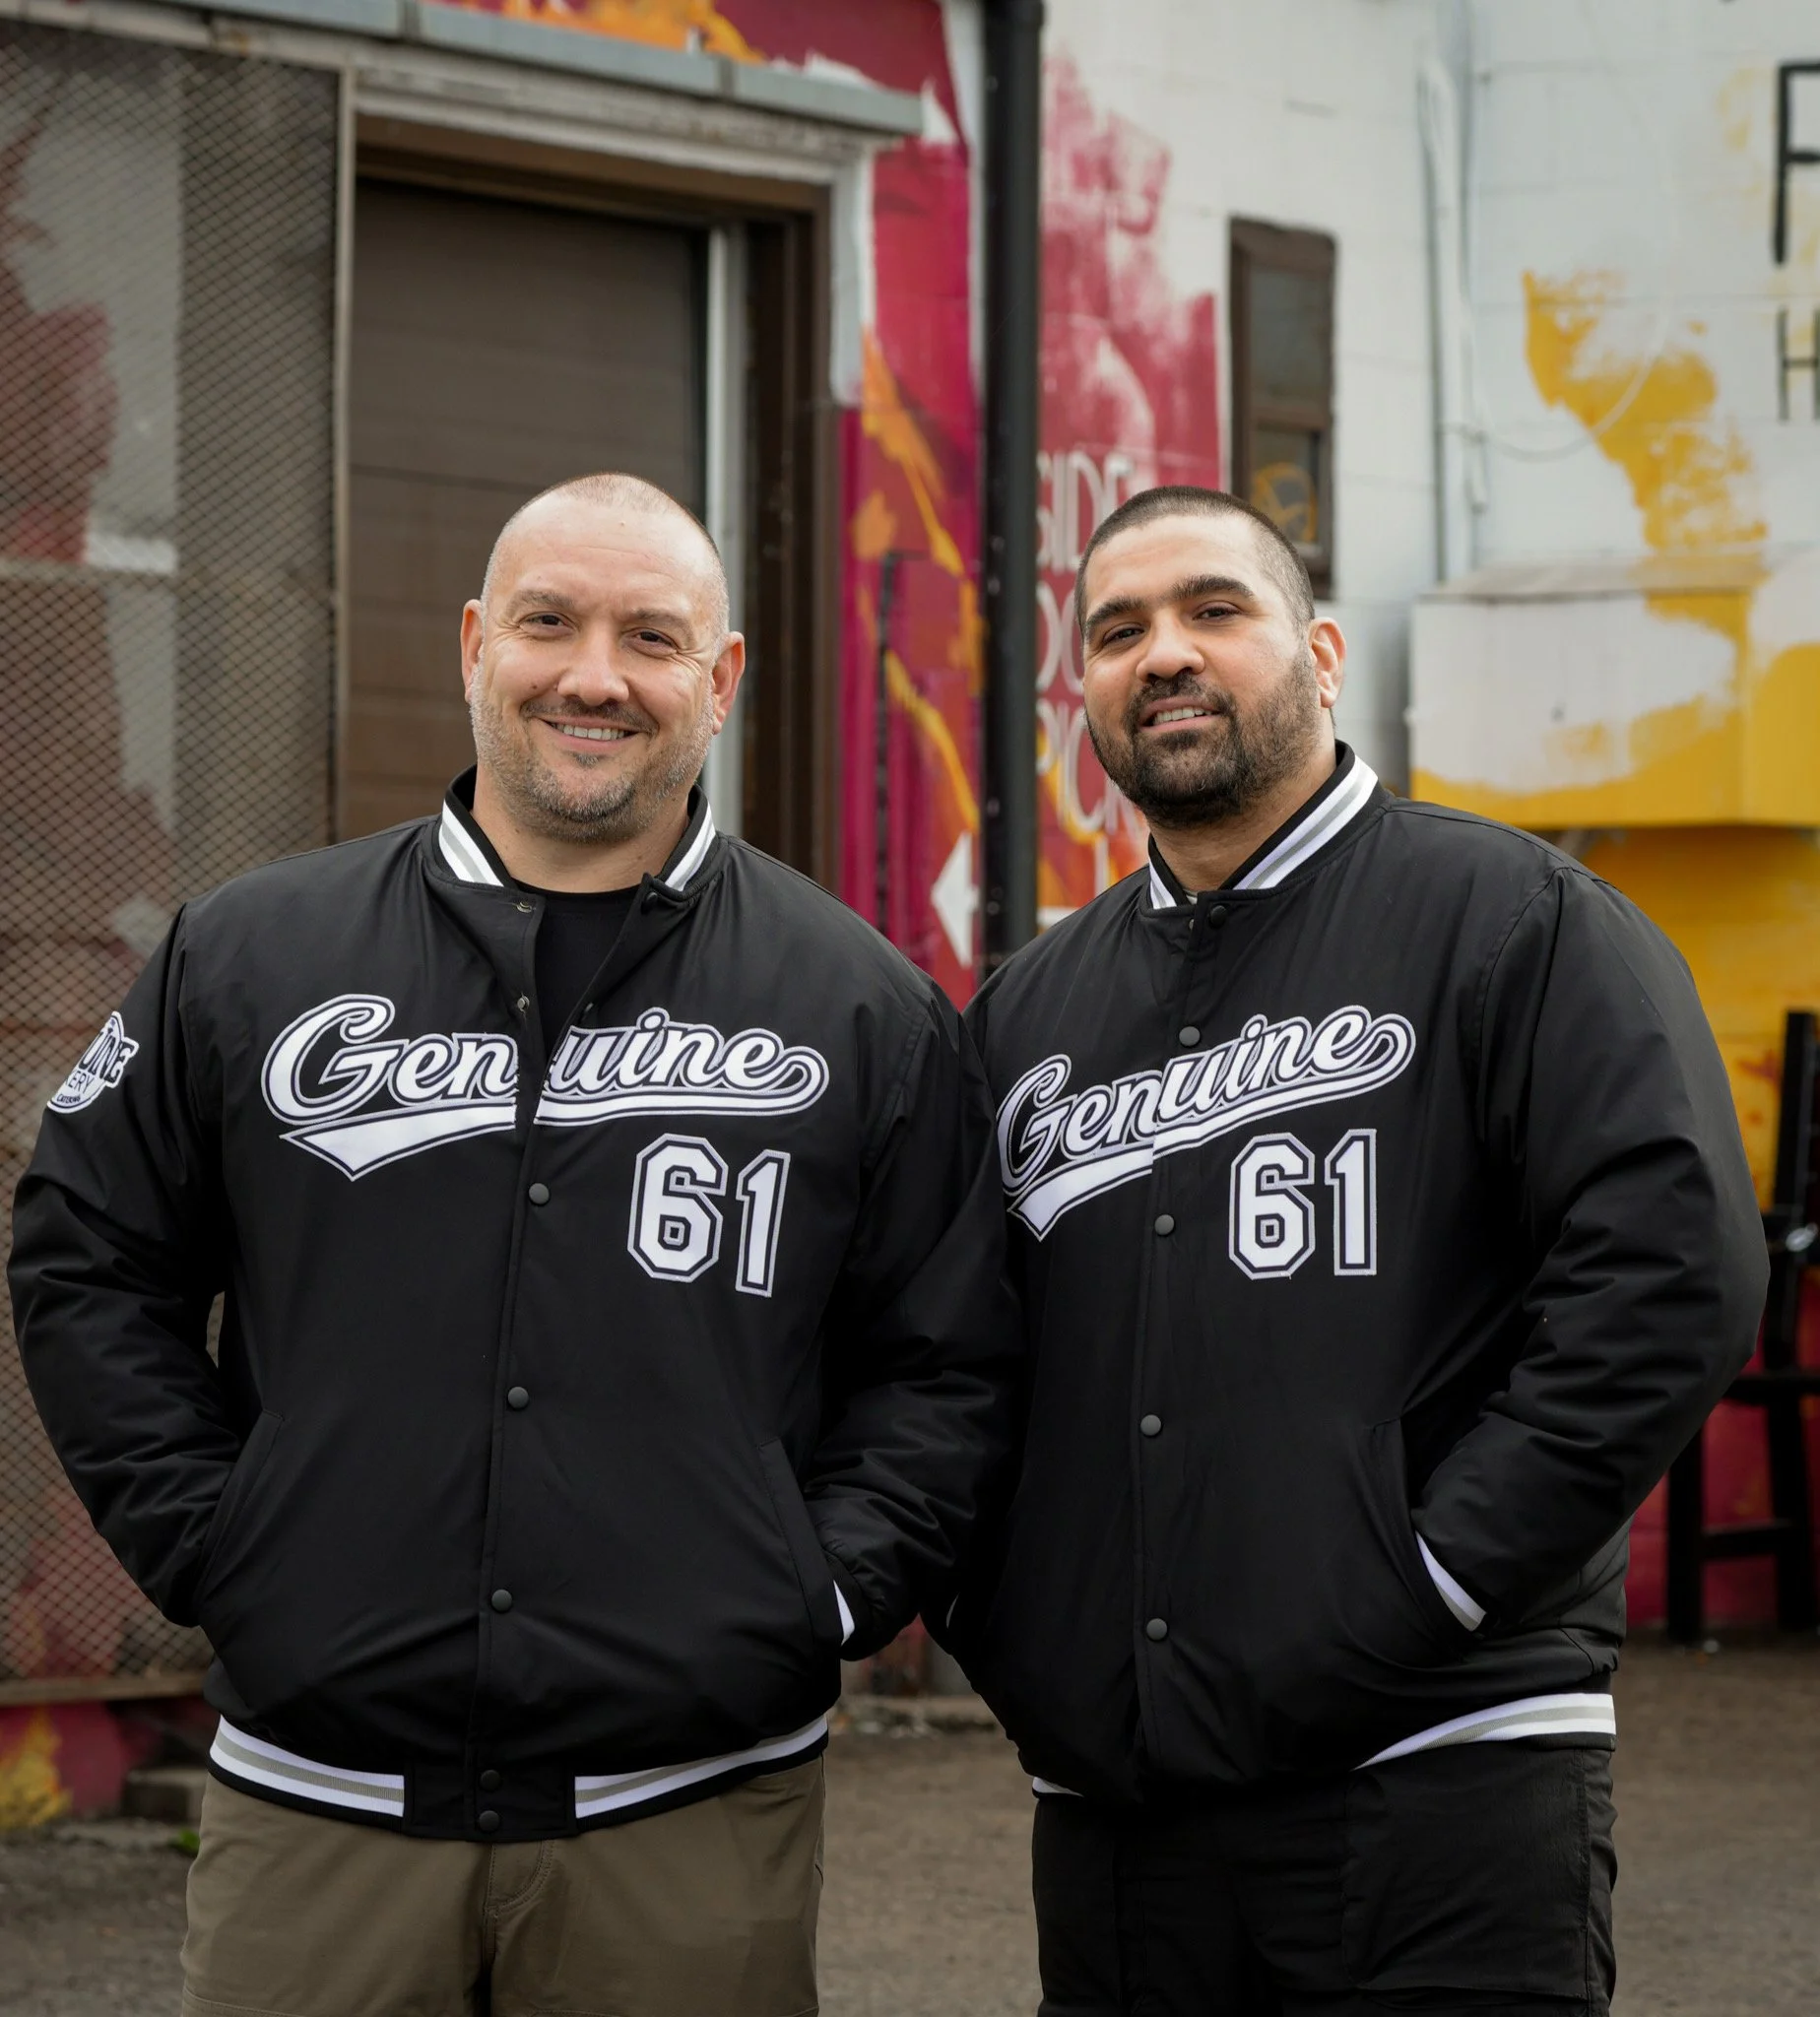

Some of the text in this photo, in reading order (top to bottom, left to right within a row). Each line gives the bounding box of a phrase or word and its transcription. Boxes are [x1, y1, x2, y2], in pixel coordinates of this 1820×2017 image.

[66, 1070, 95, 1094] ERY
[261, 994, 829, 1182] Genuine
[997, 1005, 1416, 1242] Genuine
[627, 1133, 791, 1297] 61
[1228, 1129, 1377, 1280] 61
